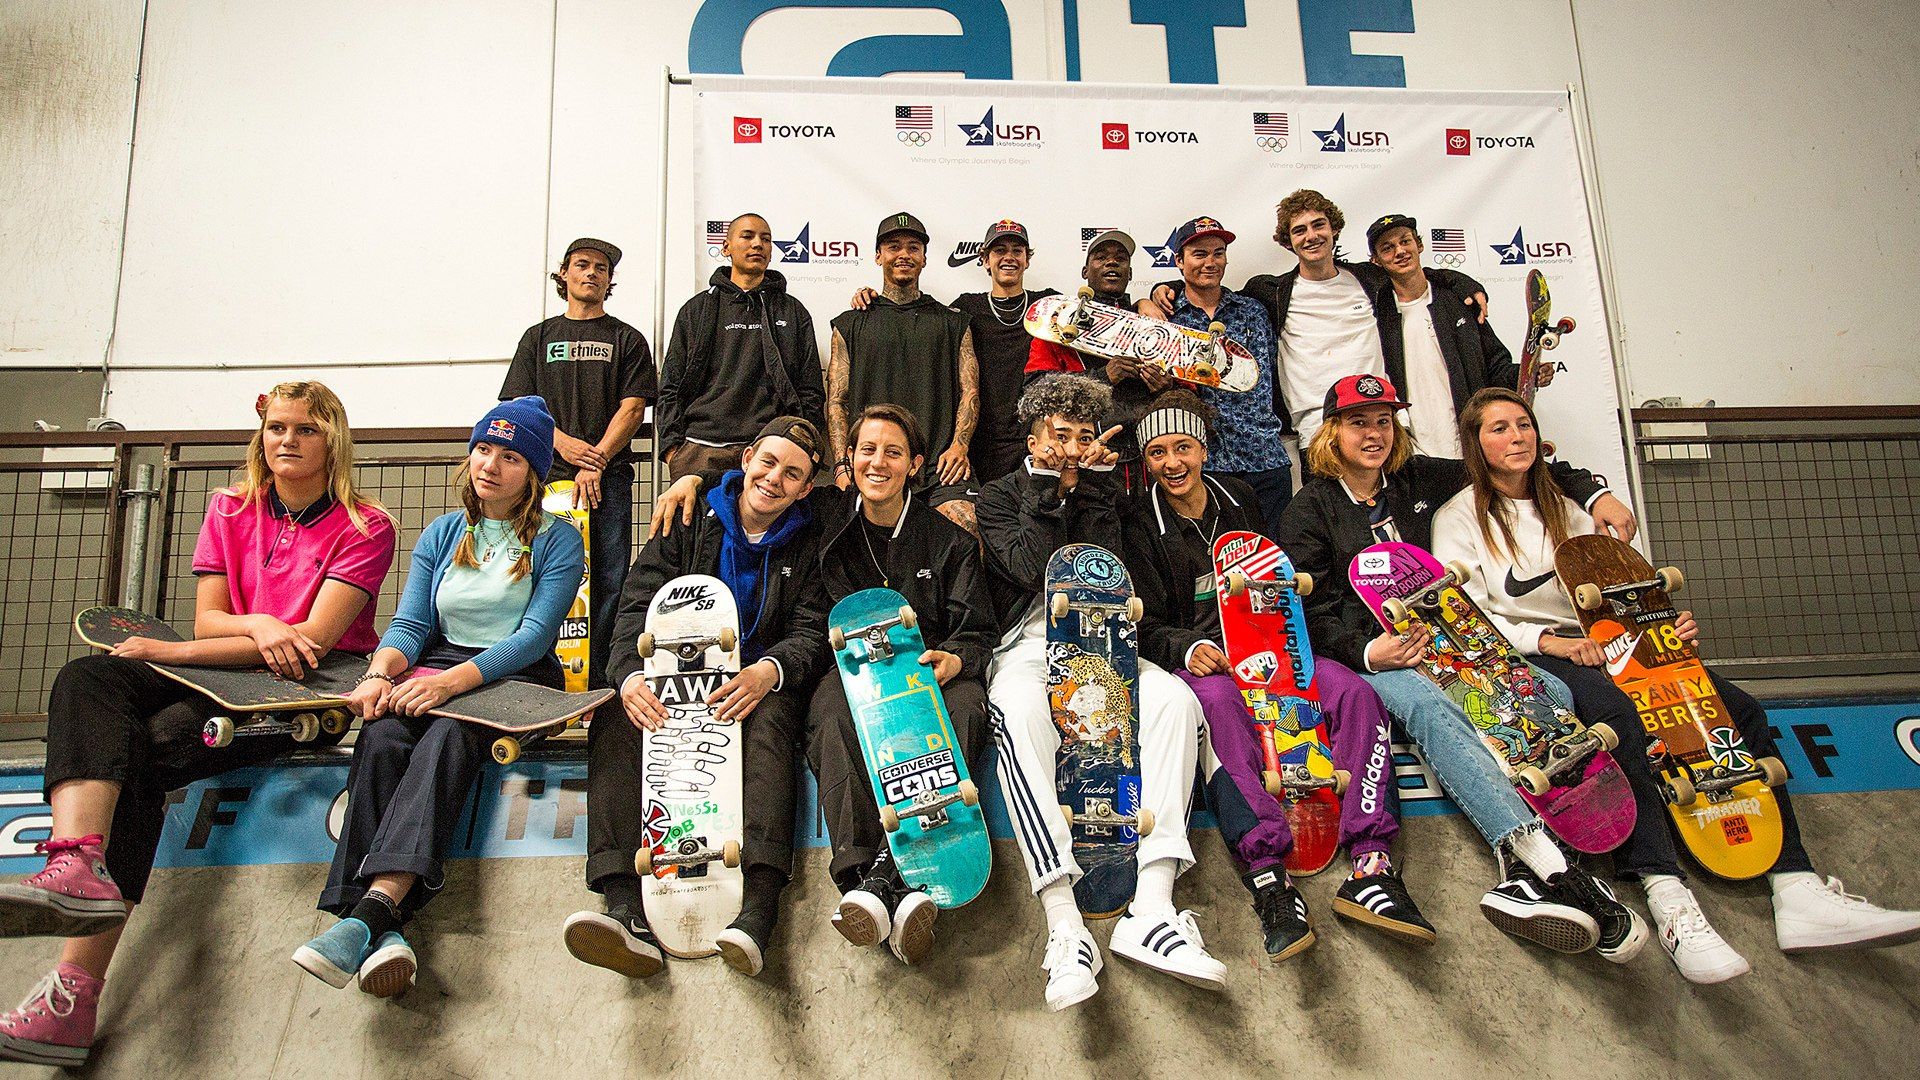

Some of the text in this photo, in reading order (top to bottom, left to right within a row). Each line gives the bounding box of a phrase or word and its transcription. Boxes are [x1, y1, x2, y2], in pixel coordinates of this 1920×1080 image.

[769, 125, 836, 138] TOYOTA
[996, 125, 1041, 140] USA
[1135, 131, 1198, 144] TOYOTA
[1347, 131, 1389, 146] USA
[996, 141, 1041, 149] skateboarding
[1475, 136, 1535, 149] TOYOTA
[911, 156, 1031, 167] Where Olympic Journeys Begin
[1295, 162, 1324, 170] Olympic
[812, 241, 859, 257] USA
[1526, 242, 1572, 258] USA
[811, 257, 859, 266] skateboarding
[824, 275, 848, 284] Begin
[571, 344, 609, 358] etnies
[1098, 572, 1120, 587] TRUCKS
[1354, 578, 1396, 587] TOYOTA
[667, 585, 709, 600] NIKE
[694, 599, 716, 611] SB
[1636, 611, 1670, 624] SPITFIRE
[560, 620, 587, 638] ies
[1603, 631, 1634, 661] NIKE
[1646, 625, 1683, 653] 18
[1278, 623, 1309, 691] mariah
[1655, 648, 1693, 664] MILE
[906, 672, 923, 689] K
[1640, 700, 1718, 733] BERES
[877, 733, 944, 766] N D
[883, 753, 951, 780] CONVERSE
[1360, 742, 1387, 814] adidas
[1078, 779, 1117, 794] Tucker
[1689, 797, 1764, 831] THRASHER
[1723, 817, 1745, 830] ANTI
[1725, 826, 1749, 839] HERO
